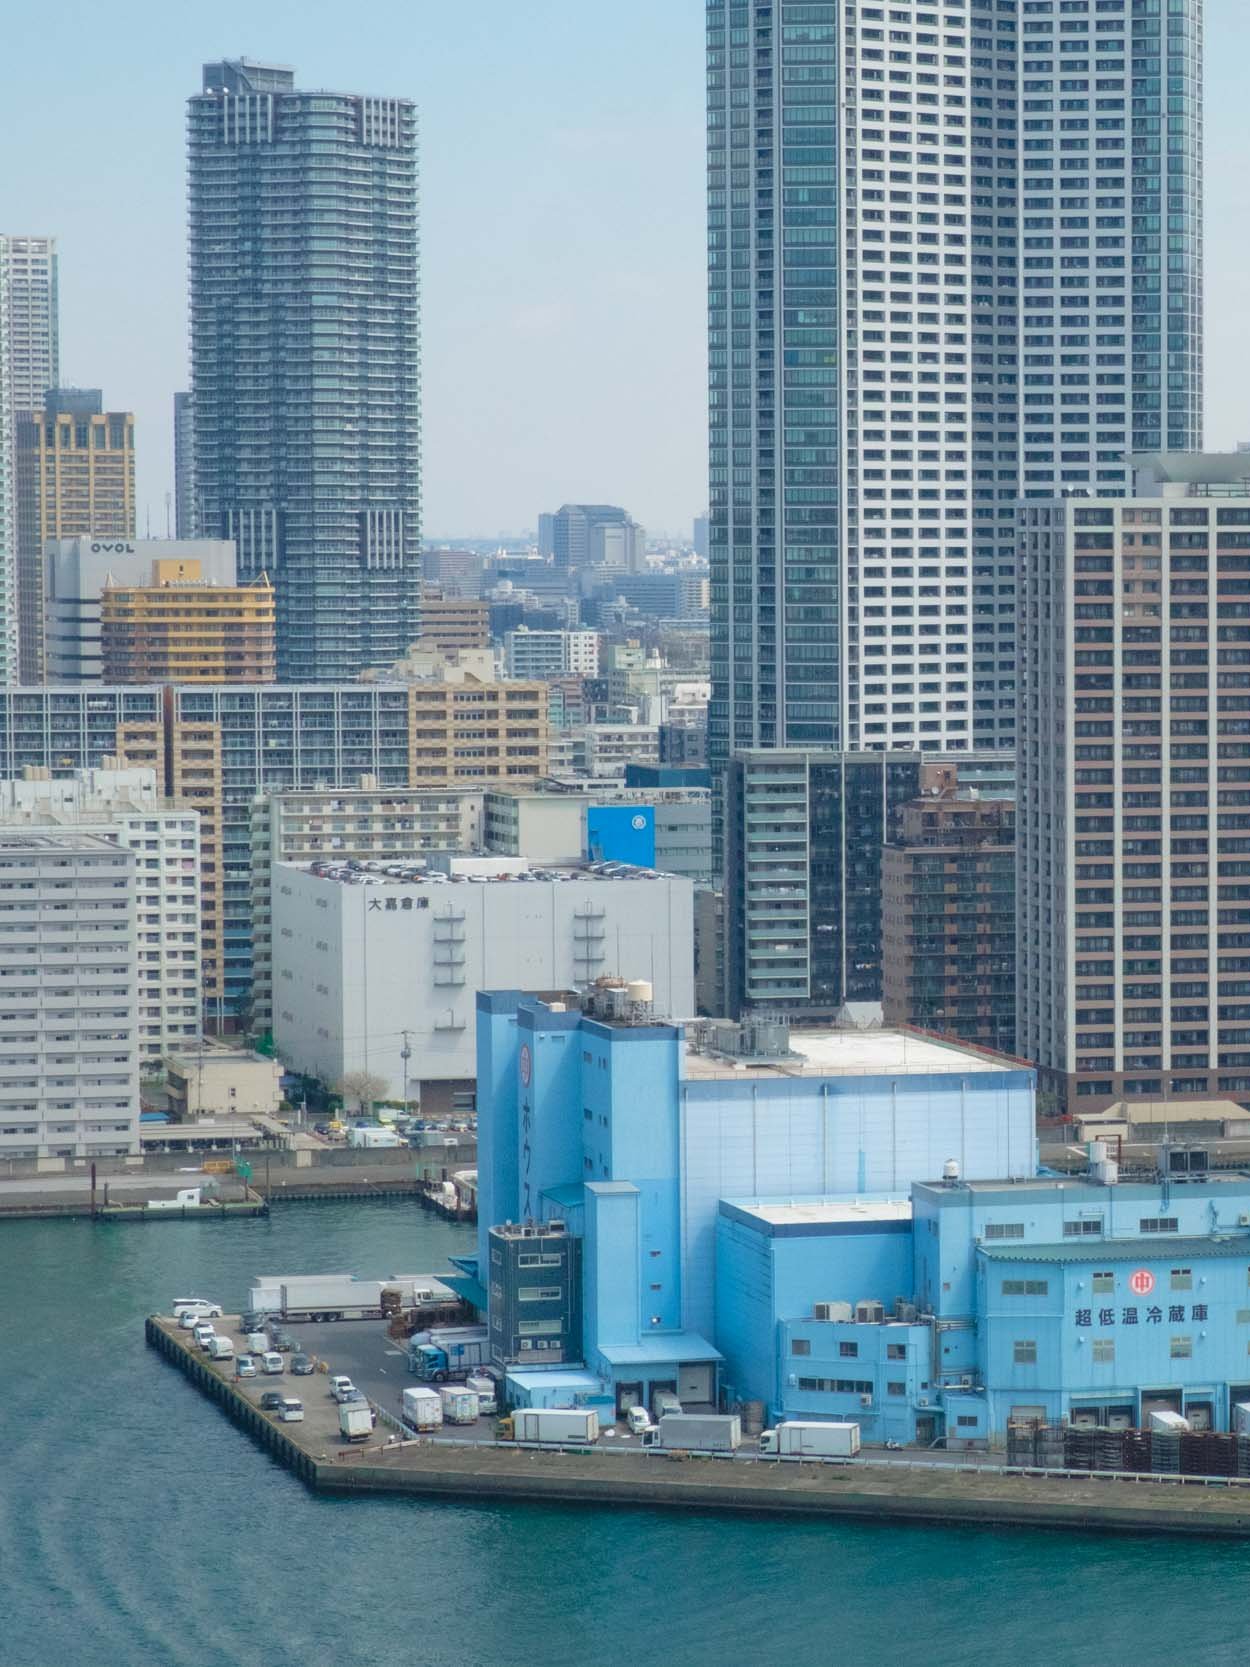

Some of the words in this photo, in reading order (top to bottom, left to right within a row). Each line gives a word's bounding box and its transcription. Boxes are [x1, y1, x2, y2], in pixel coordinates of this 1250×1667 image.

[91, 543, 135, 553] OVOL
[1075, 1304, 1209, 1327] 超低温冷蔵庫
